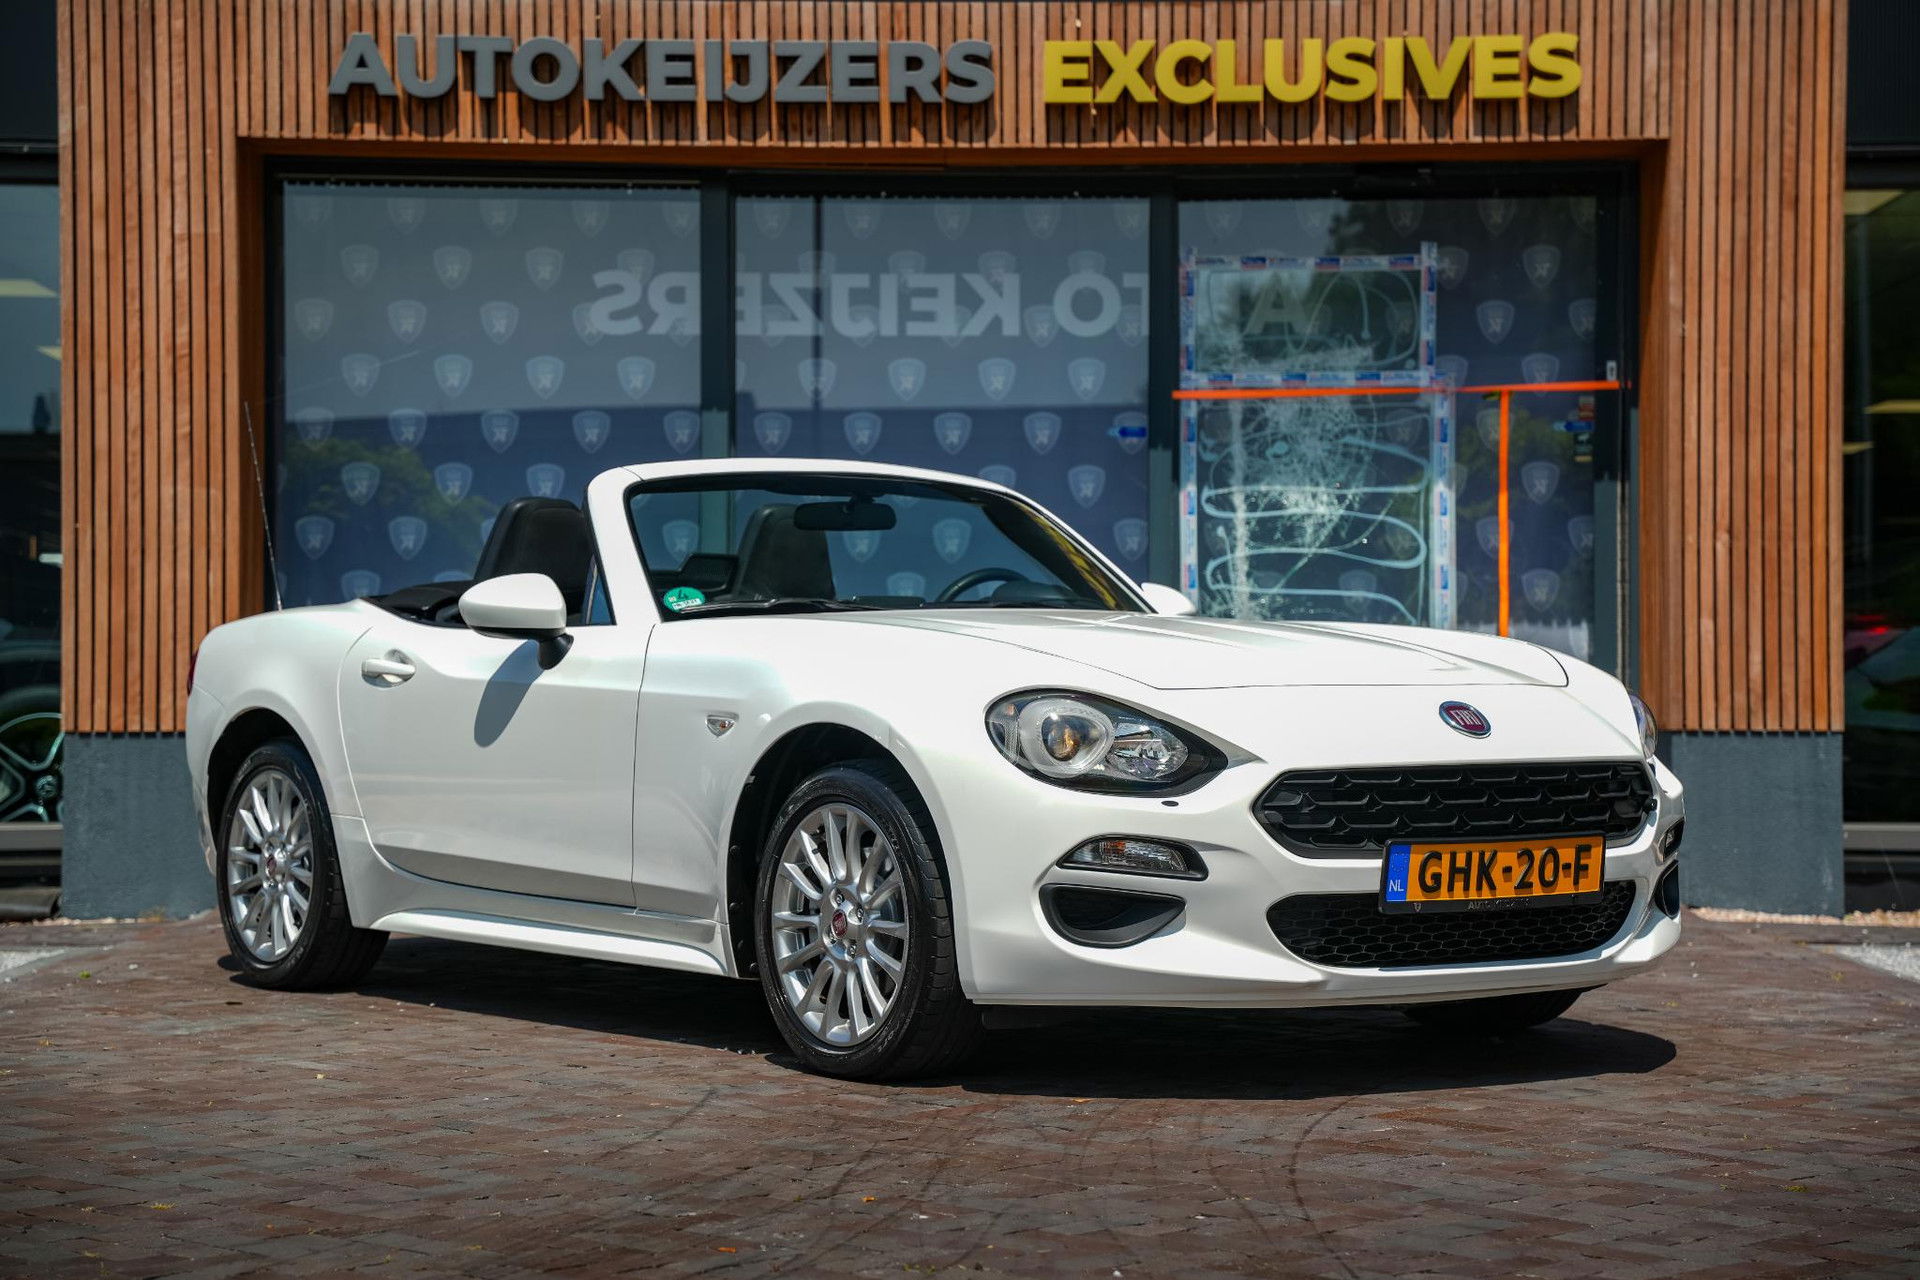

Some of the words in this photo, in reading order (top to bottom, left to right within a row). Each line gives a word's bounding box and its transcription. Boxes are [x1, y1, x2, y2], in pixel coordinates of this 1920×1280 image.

[328, 33, 995, 103] AUTOKEIJZERS
[1043, 32, 1582, 104] EXCLUSIVES
[1388, 879, 1405, 892] NL
[1418, 844, 1592, 894] GHK-20-F
